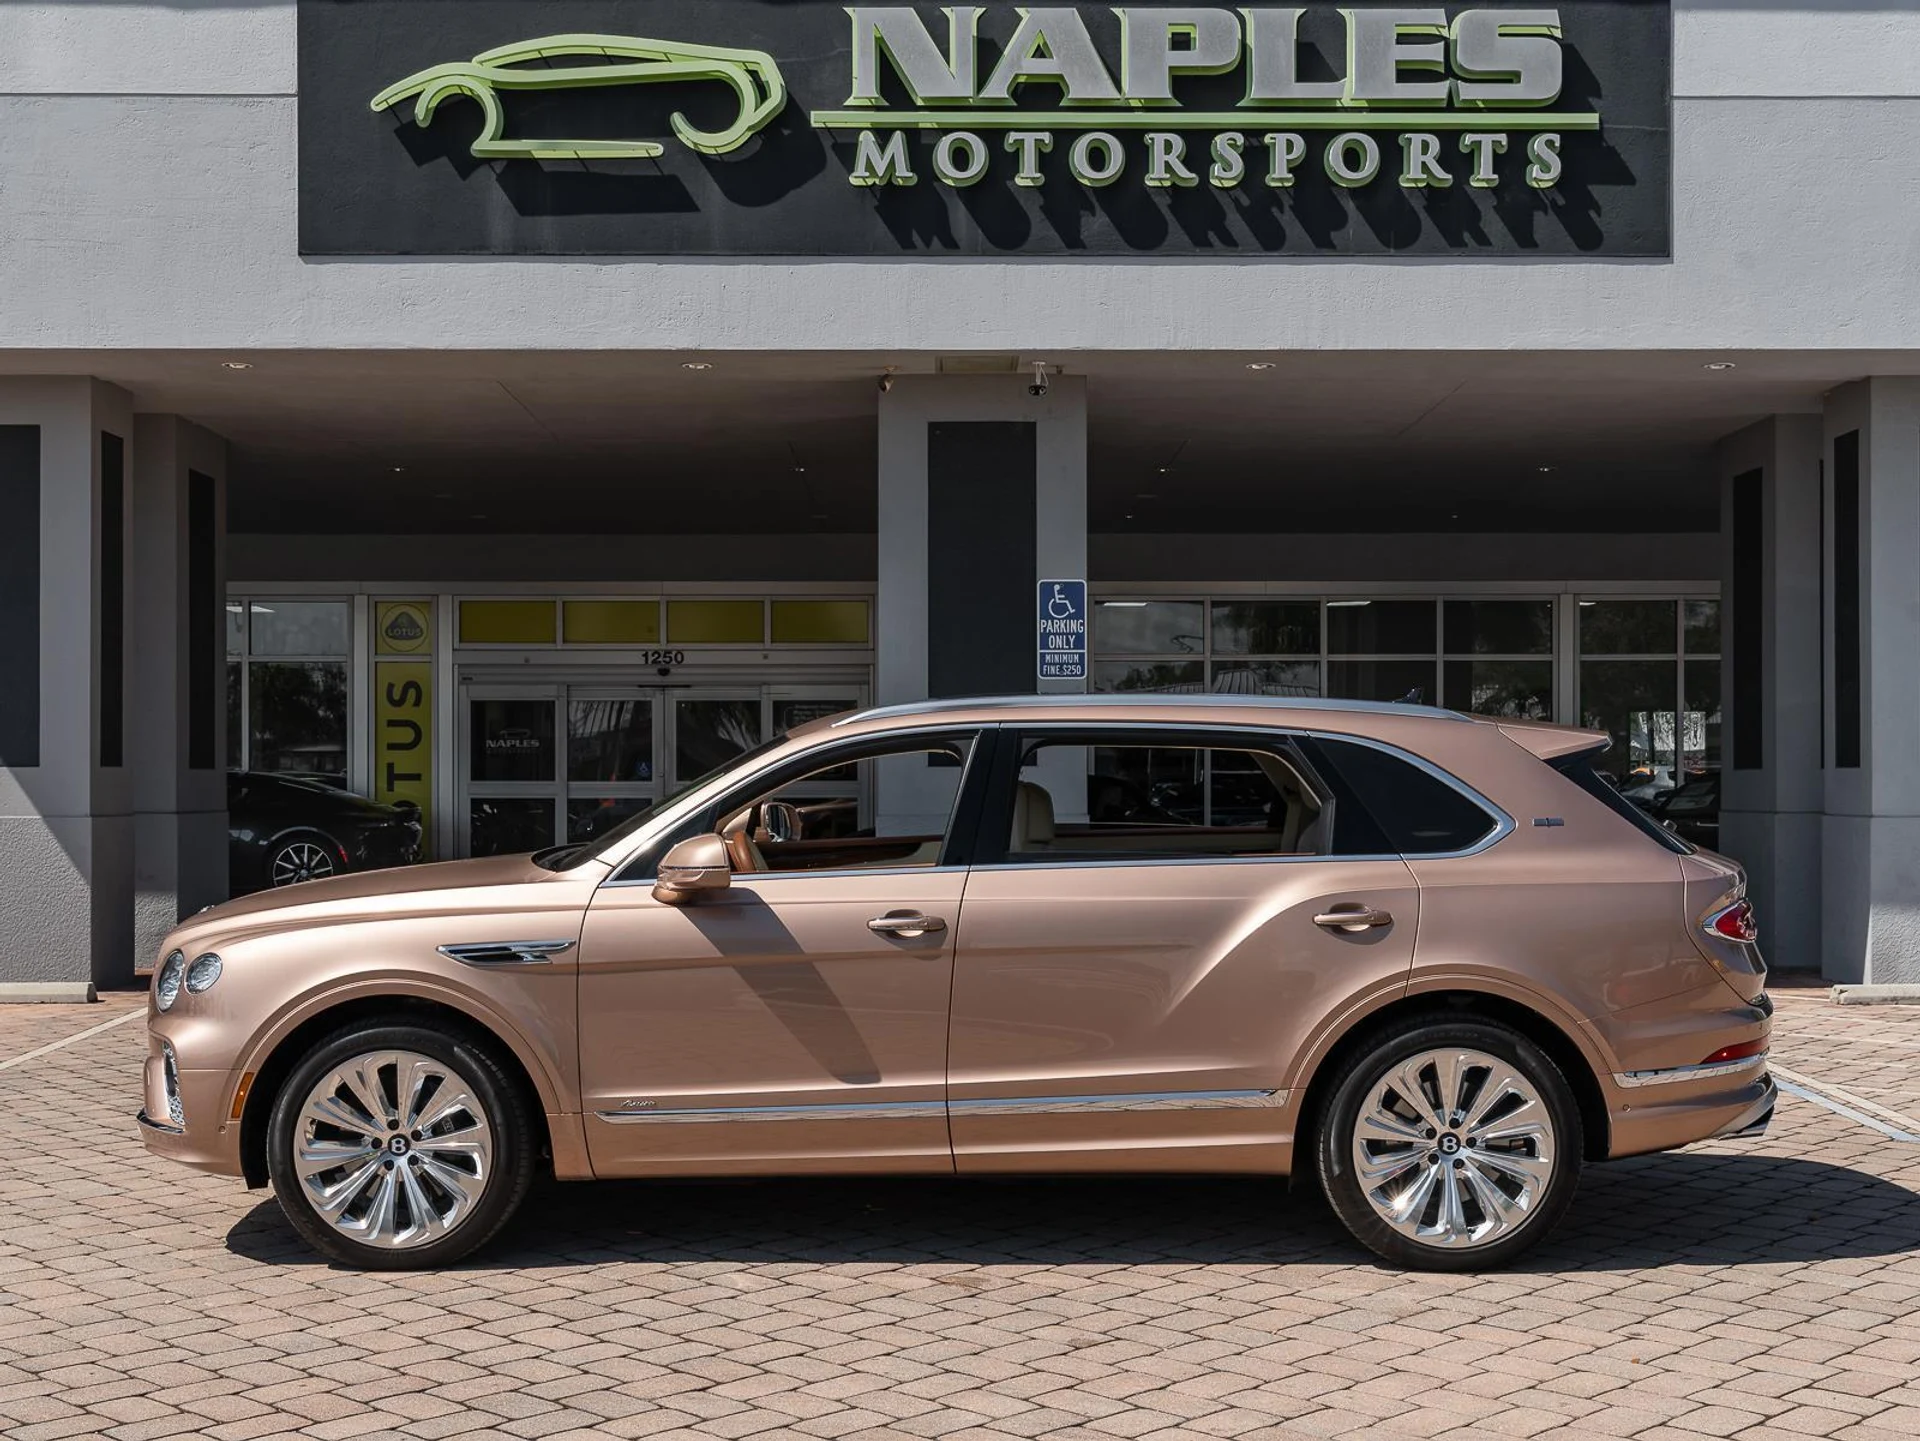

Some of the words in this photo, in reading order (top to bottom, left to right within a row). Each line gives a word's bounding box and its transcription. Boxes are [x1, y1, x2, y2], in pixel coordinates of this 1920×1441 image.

[843, 7, 1562, 107] NAPLES
[849, 130, 1562, 188] MOTORSPORTS
[1040, 619, 1084, 633] PARKING
[1048, 635, 1076, 649] ONLY
[641, 651, 684, 665] 1250
[1045, 654, 1079, 663] MINIMUM
[1043, 665, 1060, 675] FINE
[1063, 664, 1082, 676] $250
[386, 680, 423, 808] TUS
[485, 739, 540, 749] NAPLES
